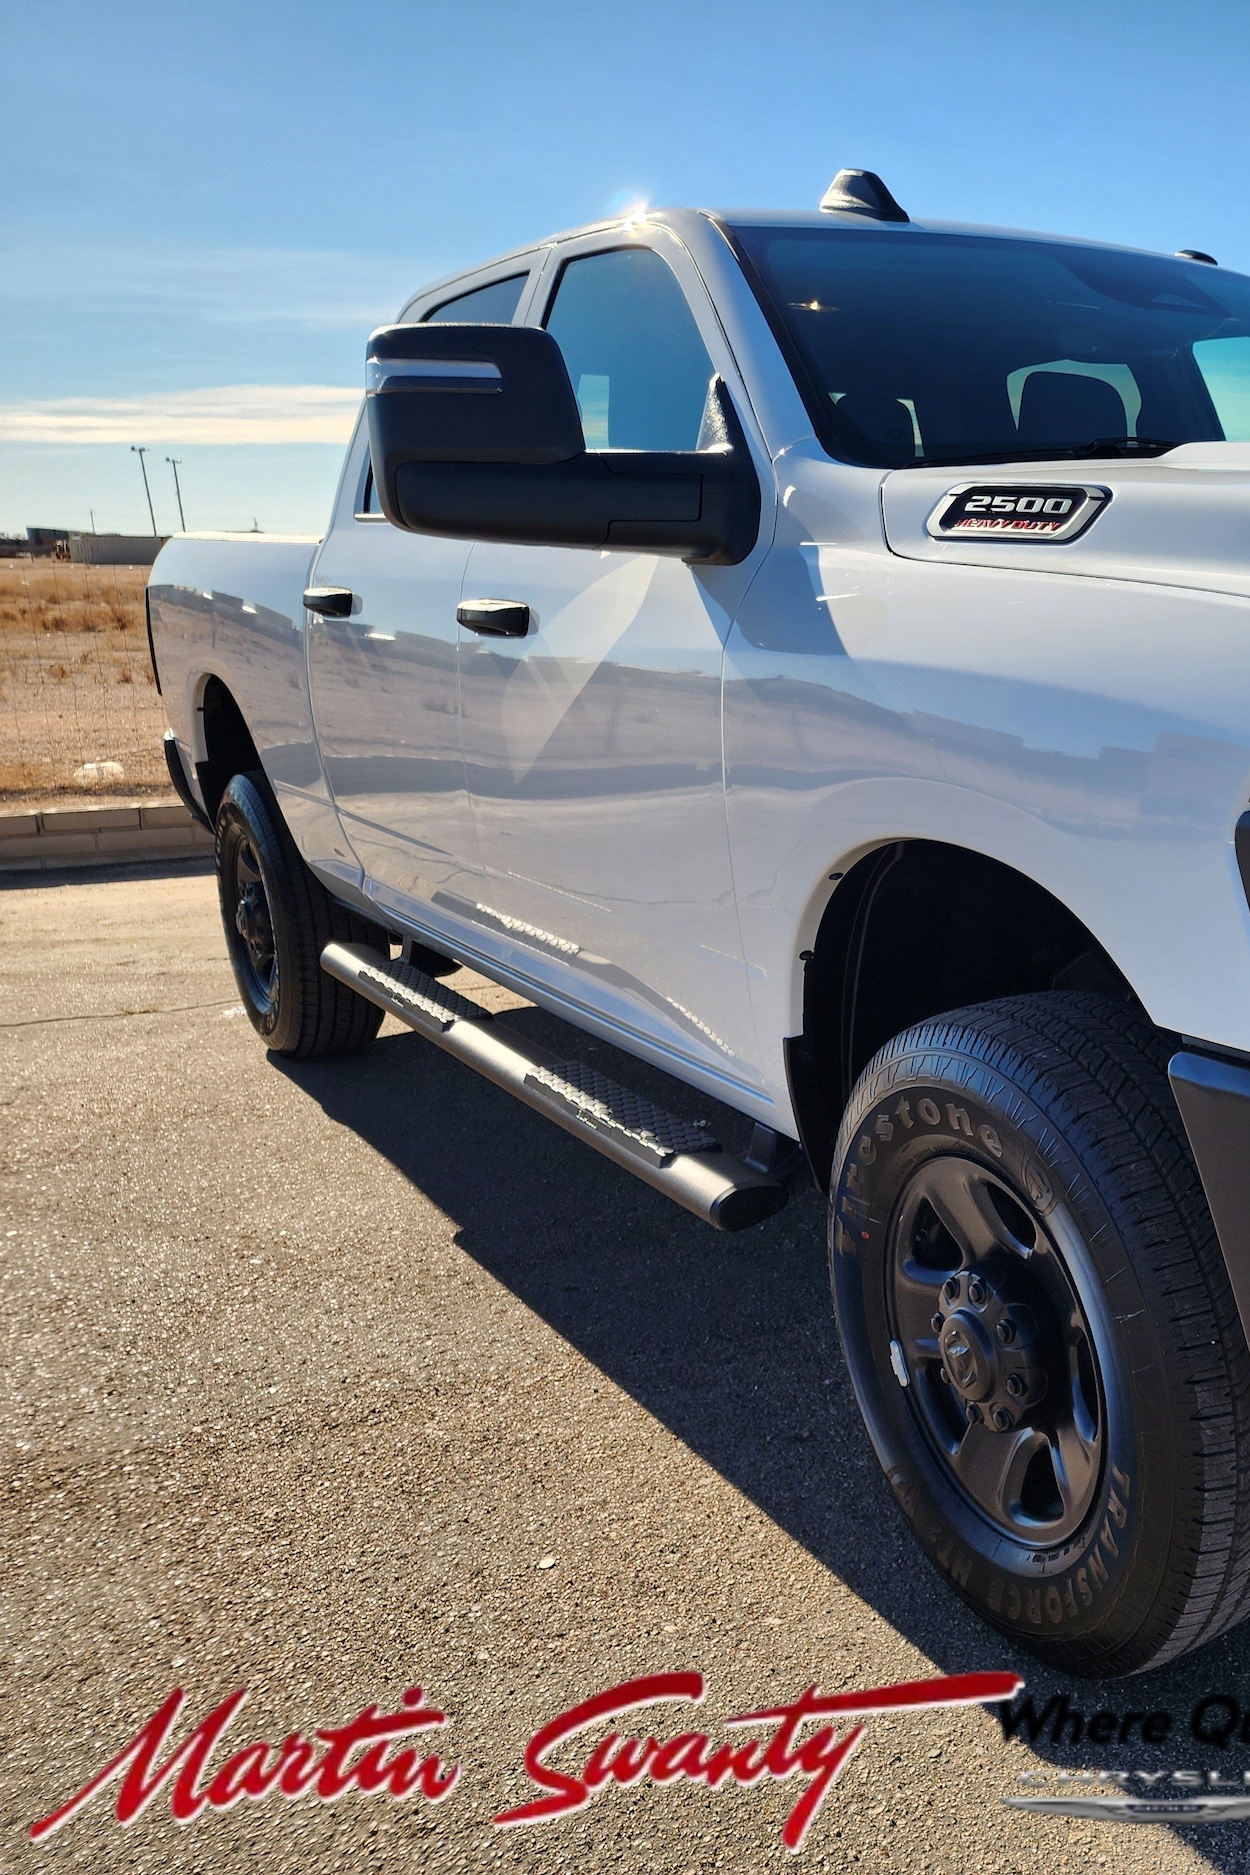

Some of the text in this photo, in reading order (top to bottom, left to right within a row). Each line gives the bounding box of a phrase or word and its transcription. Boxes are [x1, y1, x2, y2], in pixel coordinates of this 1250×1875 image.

[964, 495, 1073, 514] 2500
[954, 517, 1062, 532] HEAVY DUTY
